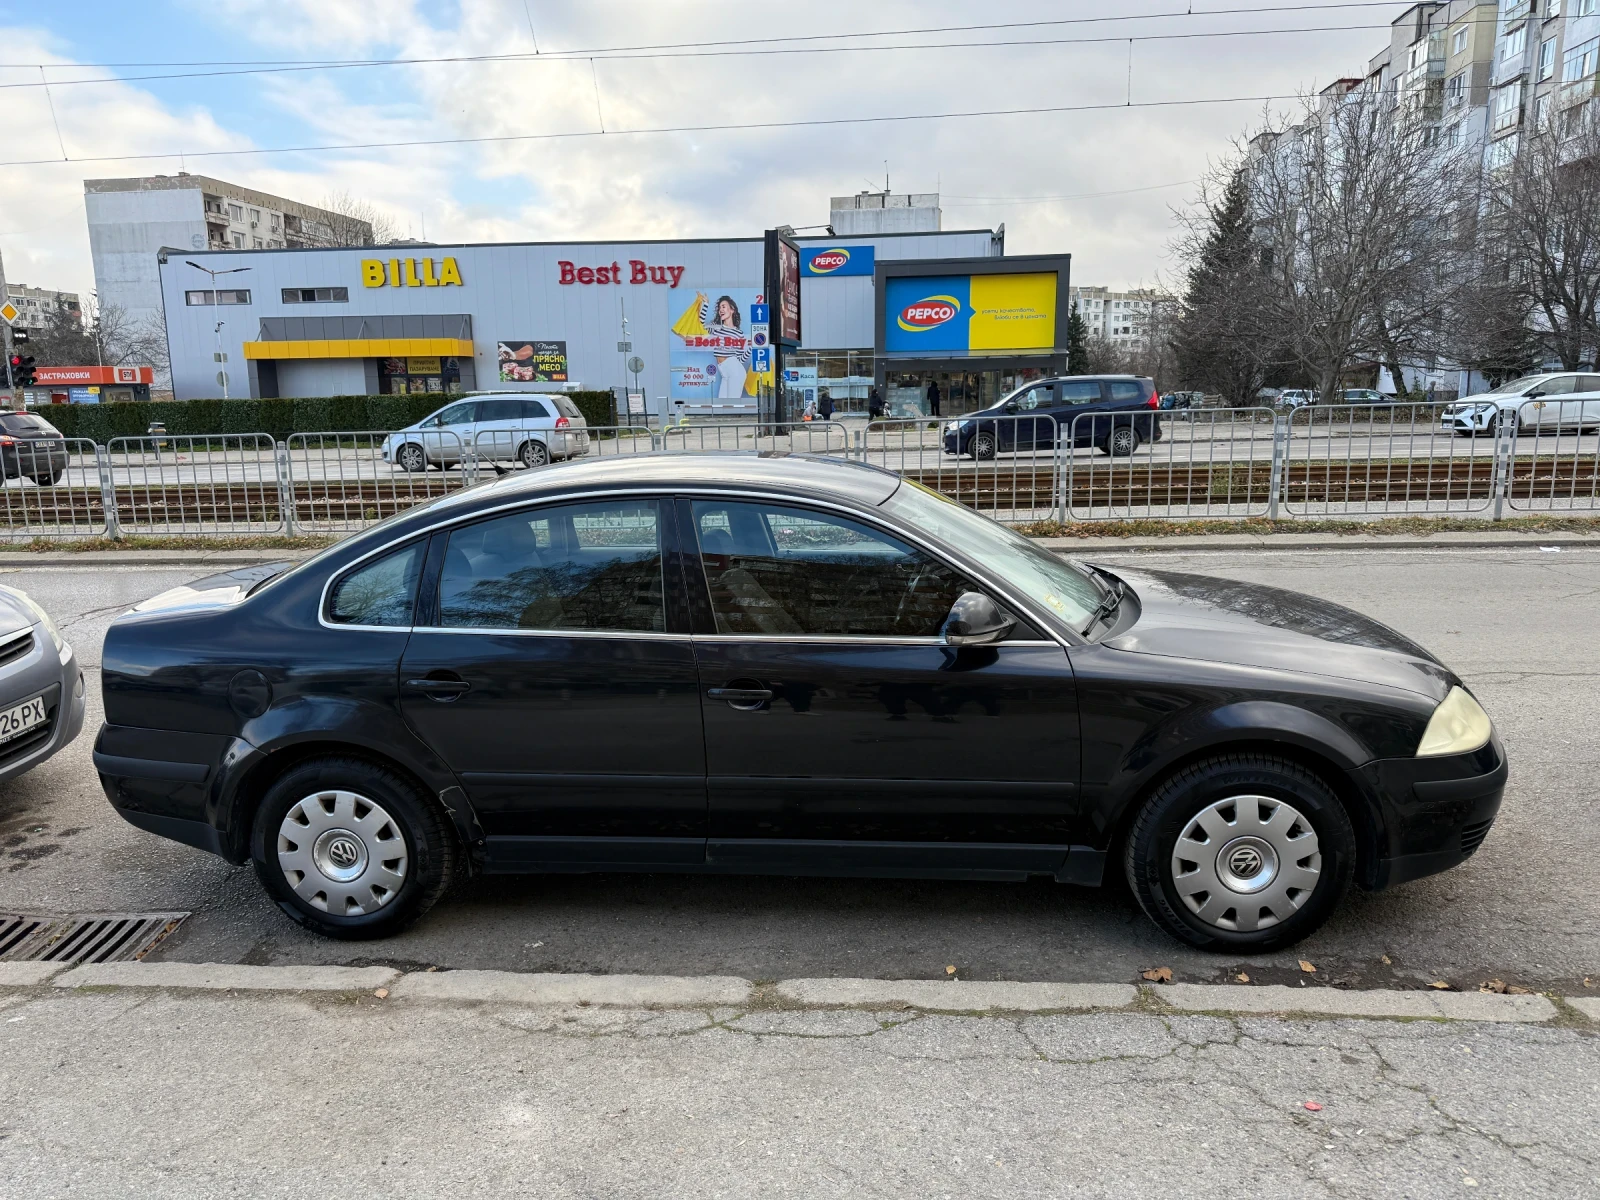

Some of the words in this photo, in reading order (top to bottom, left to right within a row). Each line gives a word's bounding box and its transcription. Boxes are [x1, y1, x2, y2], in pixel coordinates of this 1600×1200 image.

[815, 256, 844, 265] PEPCO
[361, 257, 463, 288] BILLA
[558, 260, 621, 285] Best
[629, 260, 685, 289] Buy
[907, 307, 950, 320] PEPCO
[695, 336, 720, 347] Best
[724, 336, 746, 349] Buy
[533, 355, 565, 363] ПРЯСНО
[757, 350, 765, 360] P
[539, 363, 561, 371] МЕСО
[39, 371, 90, 380] ЗАСТРАХОВКИ
